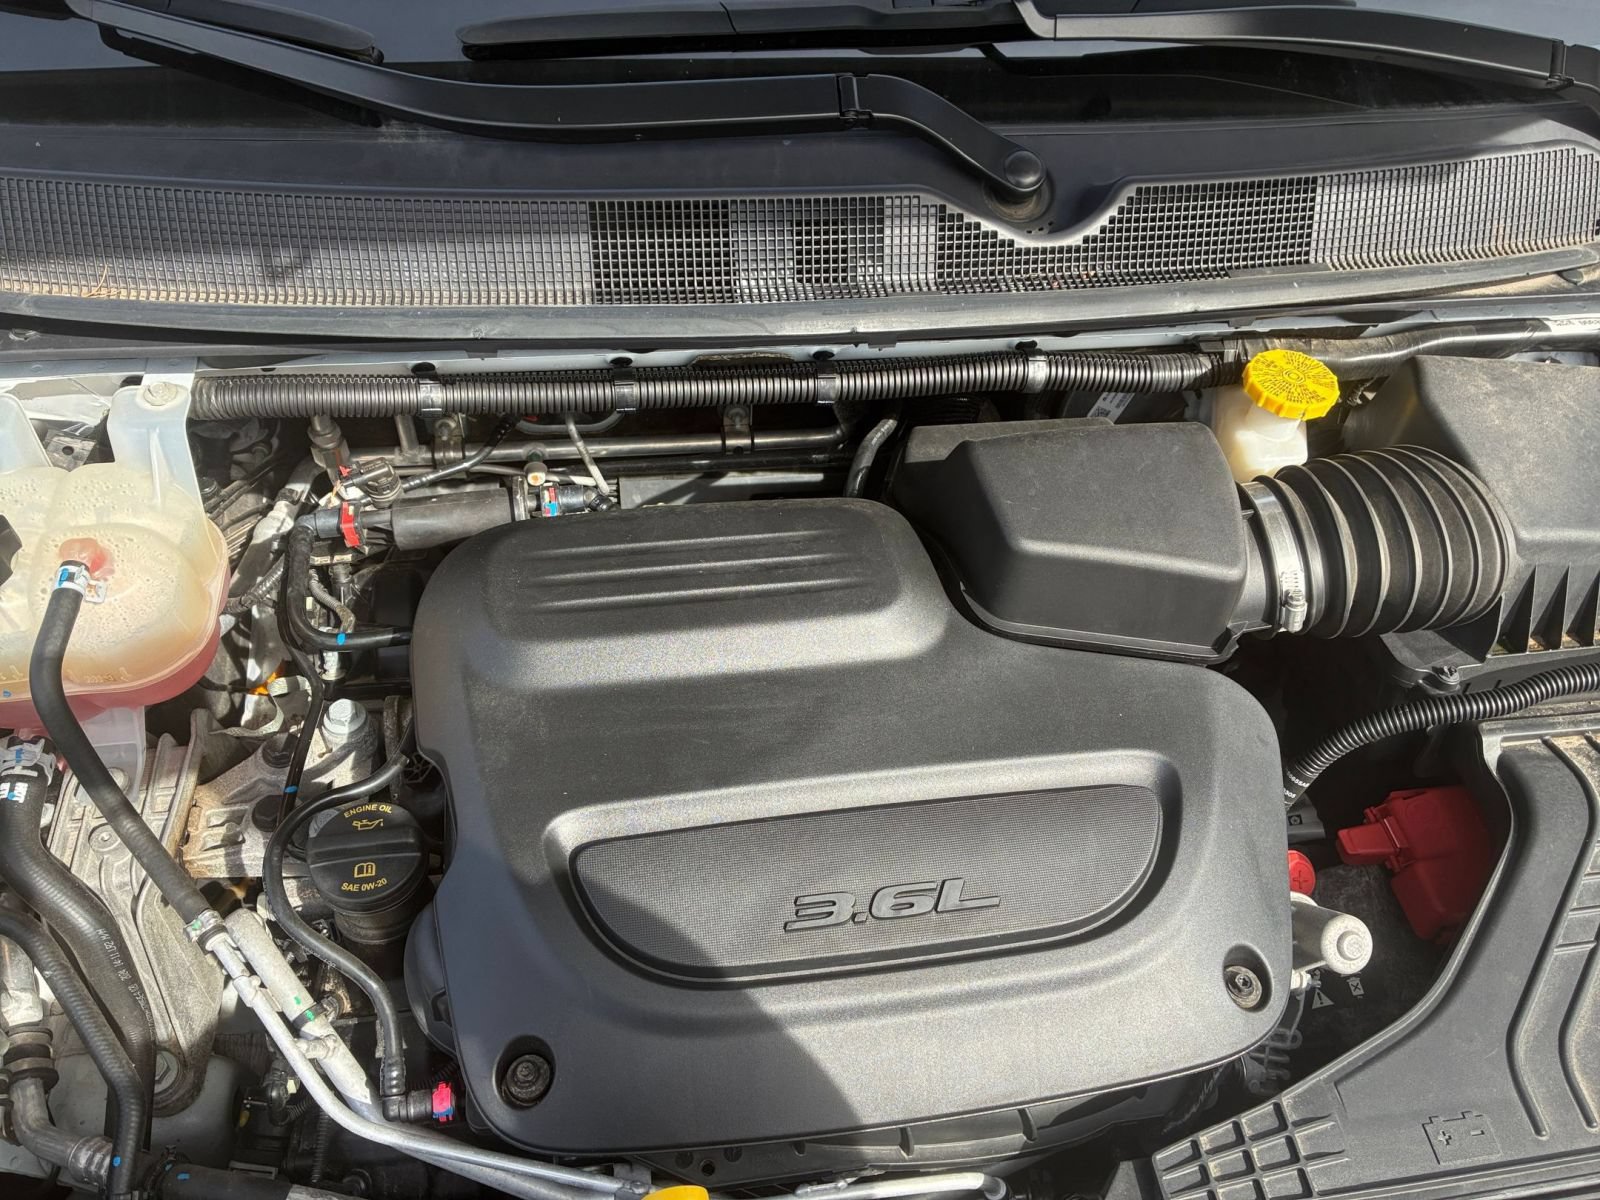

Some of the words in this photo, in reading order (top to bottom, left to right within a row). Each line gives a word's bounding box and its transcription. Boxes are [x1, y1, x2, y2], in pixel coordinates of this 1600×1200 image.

[344, 804, 377, 818] ENGINE
[378, 804, 392, 814] OIL
[341, 882, 360, 892] SAE
[361, 877, 388, 891] 0W-20
[783, 877, 1001, 933] 3.6L
